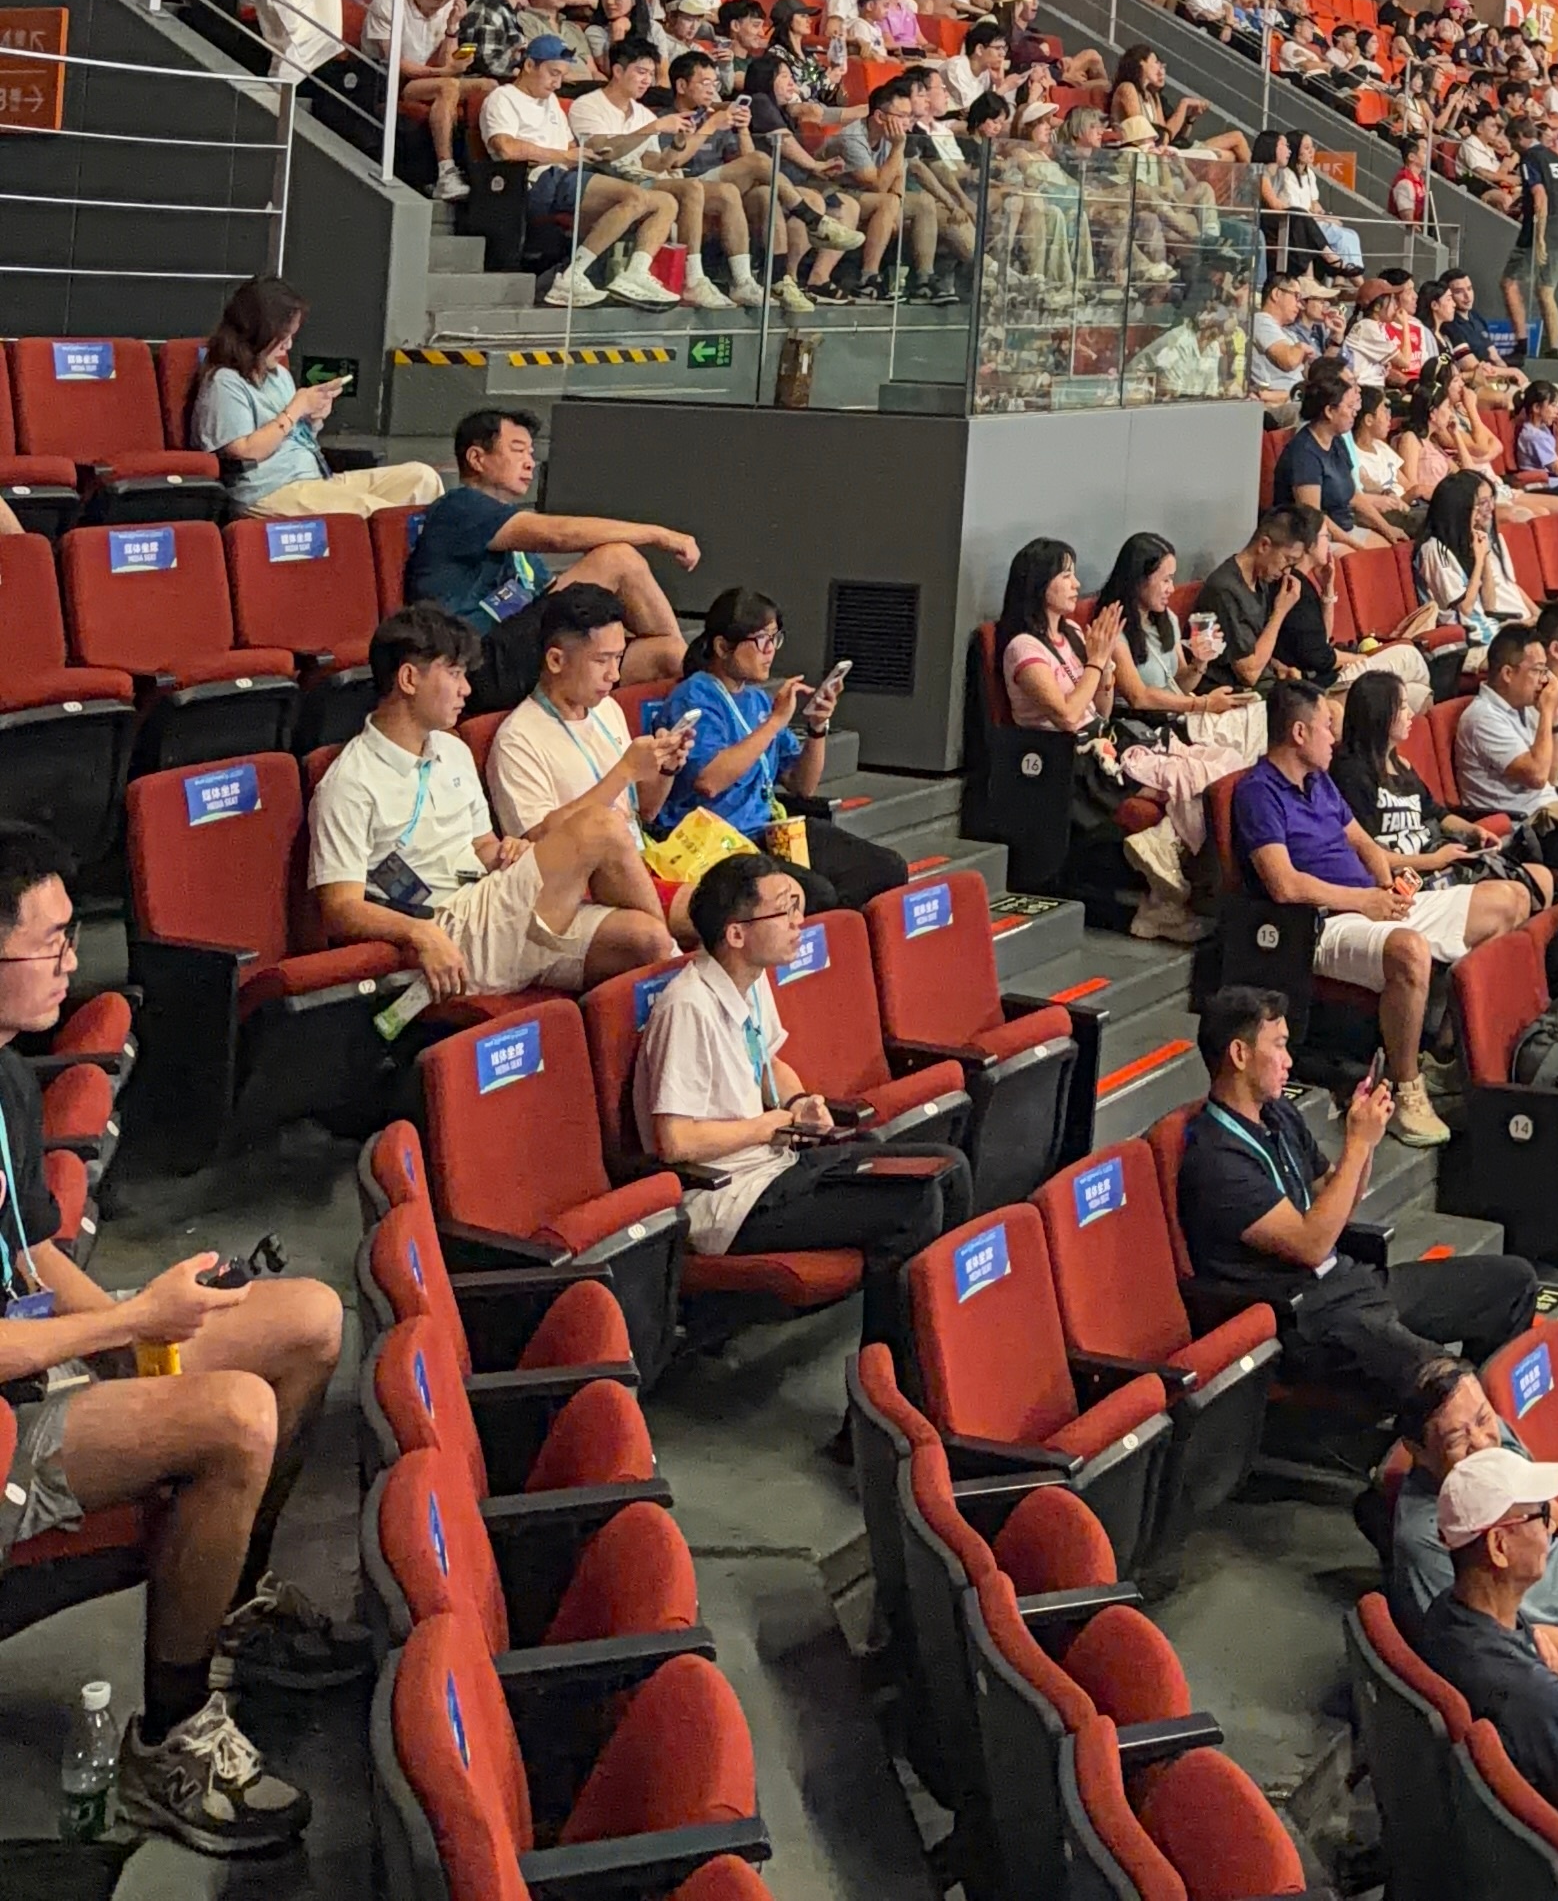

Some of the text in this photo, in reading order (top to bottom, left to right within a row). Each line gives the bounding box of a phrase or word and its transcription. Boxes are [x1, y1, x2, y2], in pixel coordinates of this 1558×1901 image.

[1025, 758, 1040, 772] 16
[1261, 930, 1276, 944] 15
[1514, 1120, 1529, 1135] 14
